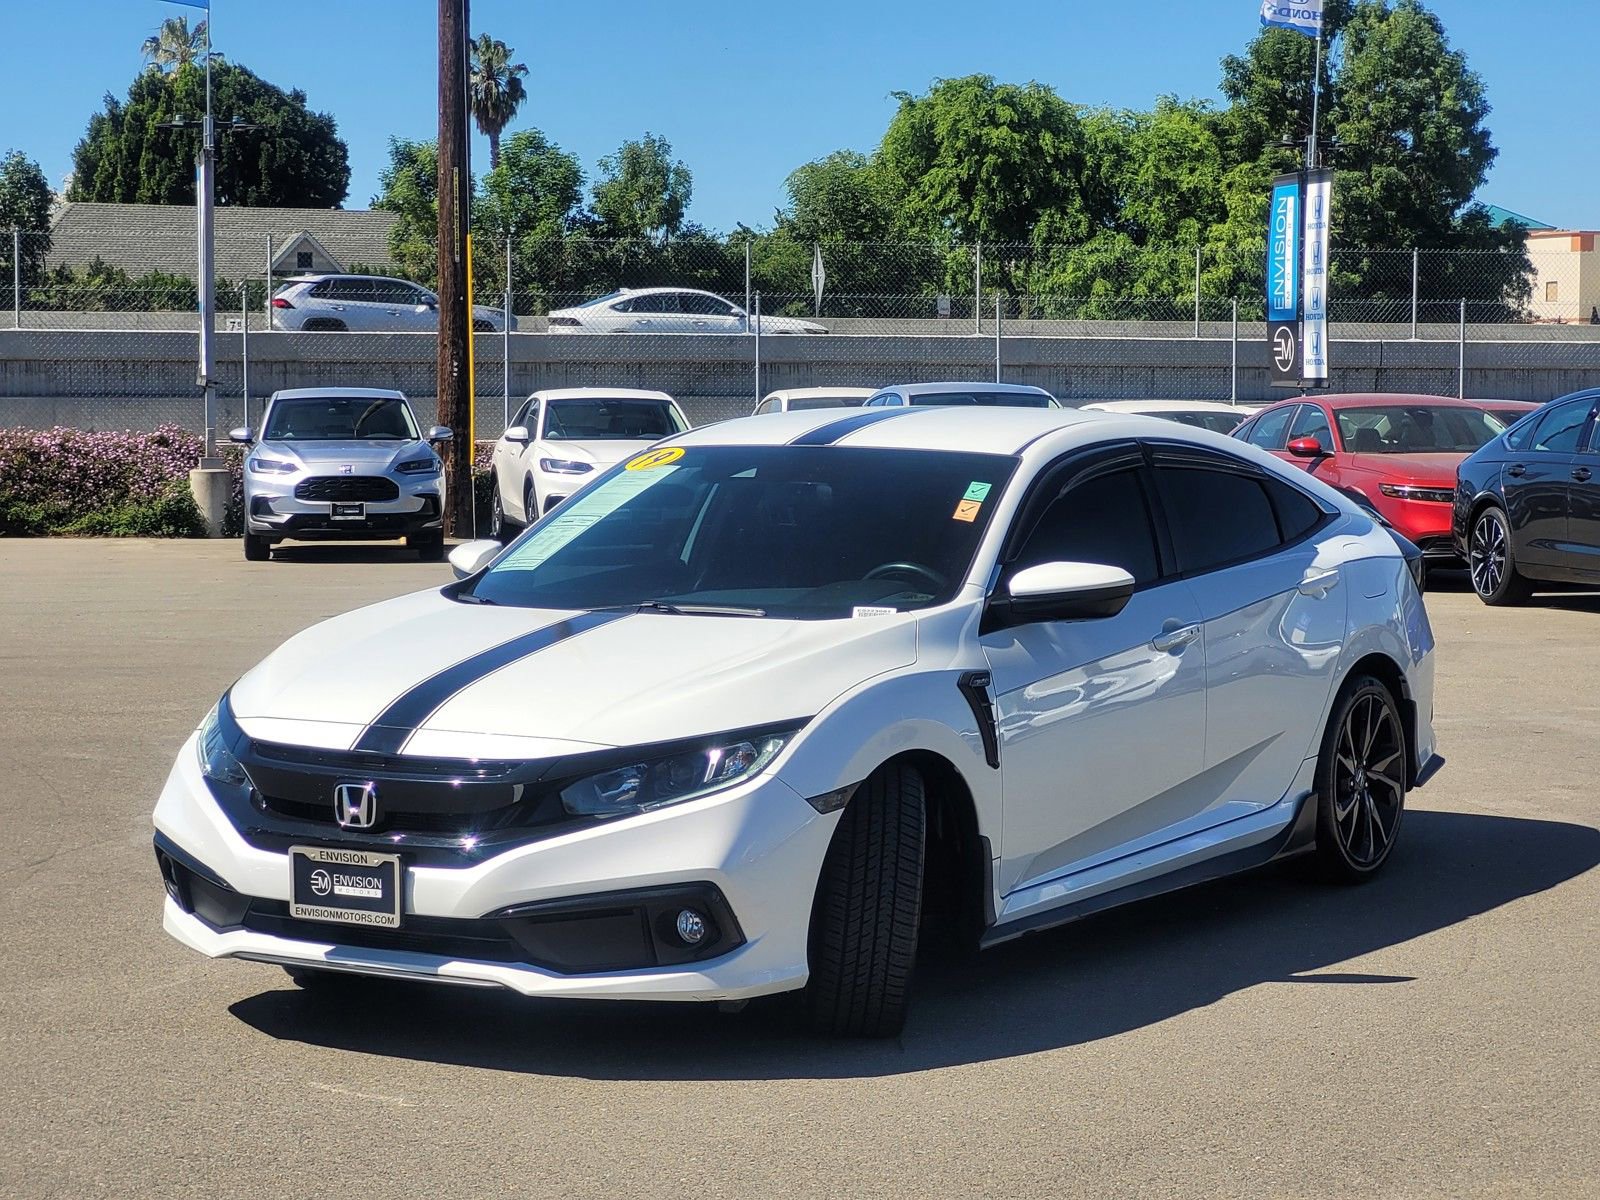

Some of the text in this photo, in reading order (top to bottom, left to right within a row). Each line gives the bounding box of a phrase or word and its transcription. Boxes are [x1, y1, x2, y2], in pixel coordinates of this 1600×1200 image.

[1307, 222, 1326, 230] HONDA
[1273, 196, 1287, 310] ENVISION
[1306, 267, 1325, 275] HONDA
[1305, 312, 1324, 320] HONDA
[1305, 358, 1325, 366] HONDA
[319, 850, 368, 864] ENVISION
[333, 873, 382, 889] ENVISION
[337, 888, 379, 896] MOTORS
[295, 906, 395, 925] ENVISIONMOTORS.COM
